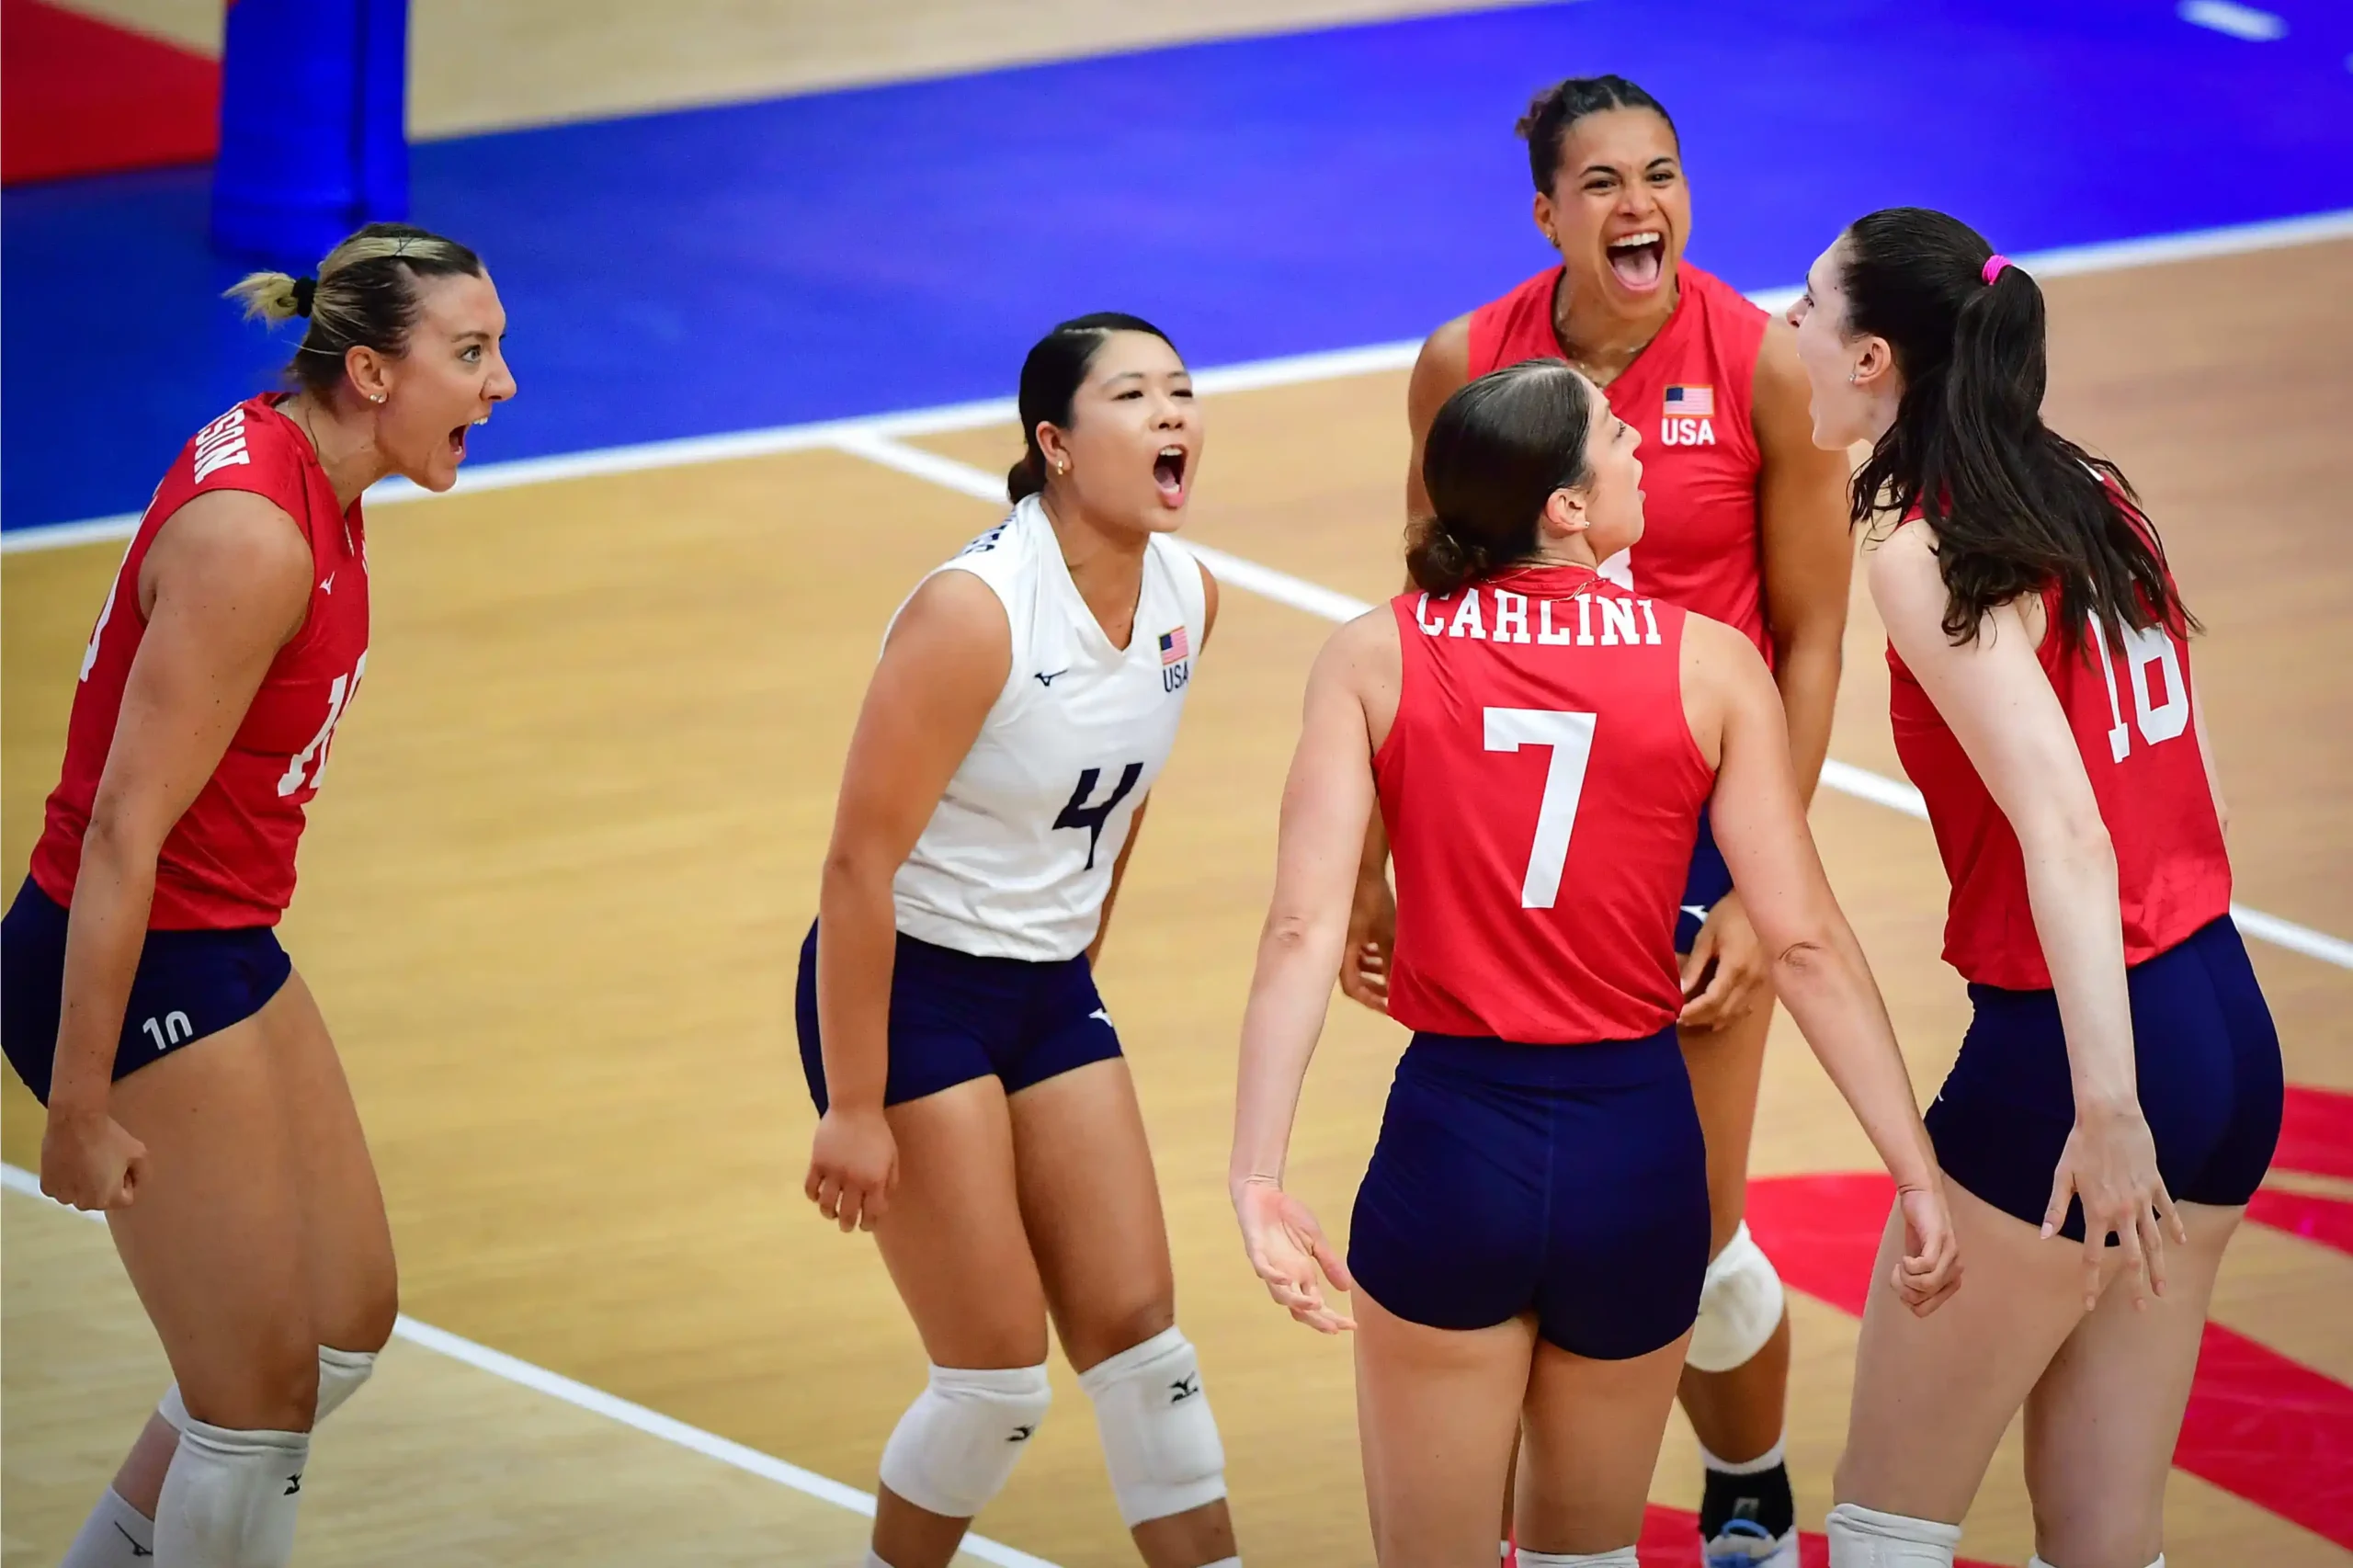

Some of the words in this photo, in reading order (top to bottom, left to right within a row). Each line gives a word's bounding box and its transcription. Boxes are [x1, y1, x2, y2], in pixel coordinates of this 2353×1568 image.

[194, 400, 250, 485] SON
[1661, 418, 1716, 446] USA
[1415, 587, 1662, 646] CARLINI
[1163, 660, 1189, 694] USA
[1051, 761, 1144, 872] 4
[1483, 706, 1597, 909] 7
[142, 1010, 194, 1051] 10
